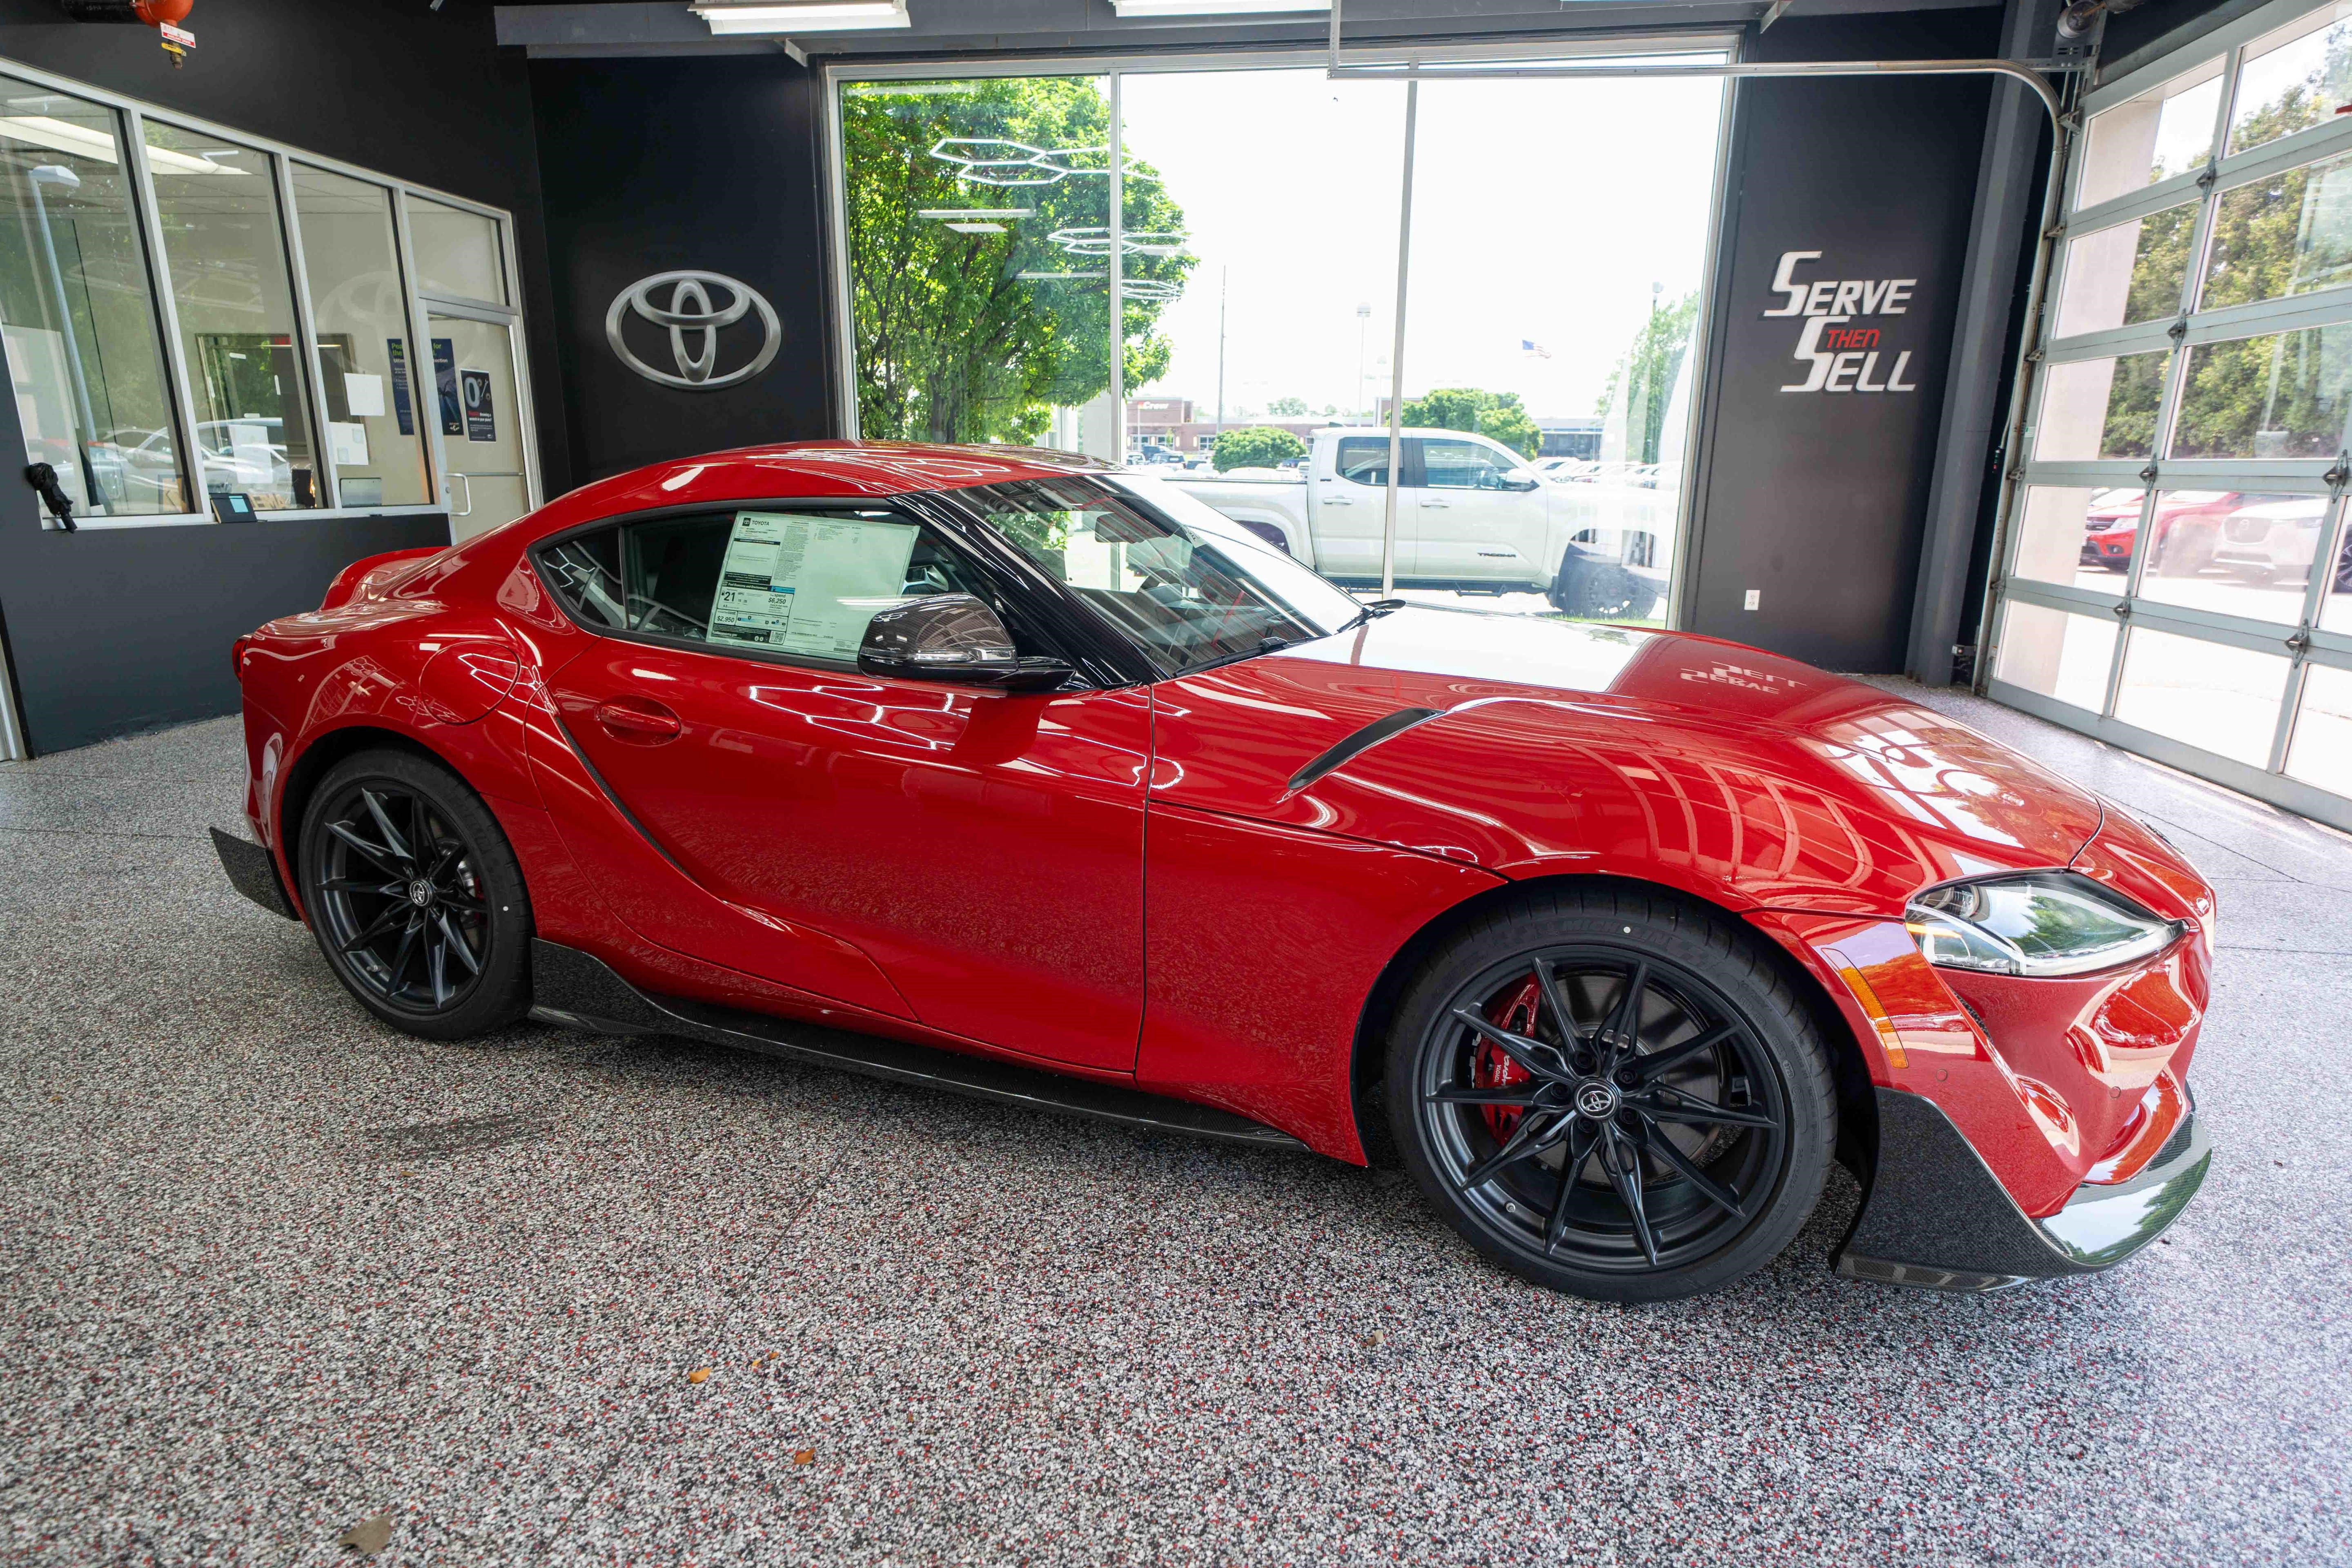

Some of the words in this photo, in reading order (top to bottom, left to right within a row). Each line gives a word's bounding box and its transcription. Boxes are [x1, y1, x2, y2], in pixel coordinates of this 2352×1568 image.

[1764, 251, 1917, 316] SERVE
[1780, 315, 1916, 392] SELL
[1827, 328, 1880, 348] THEN
[724, 591, 735, 601] 21
